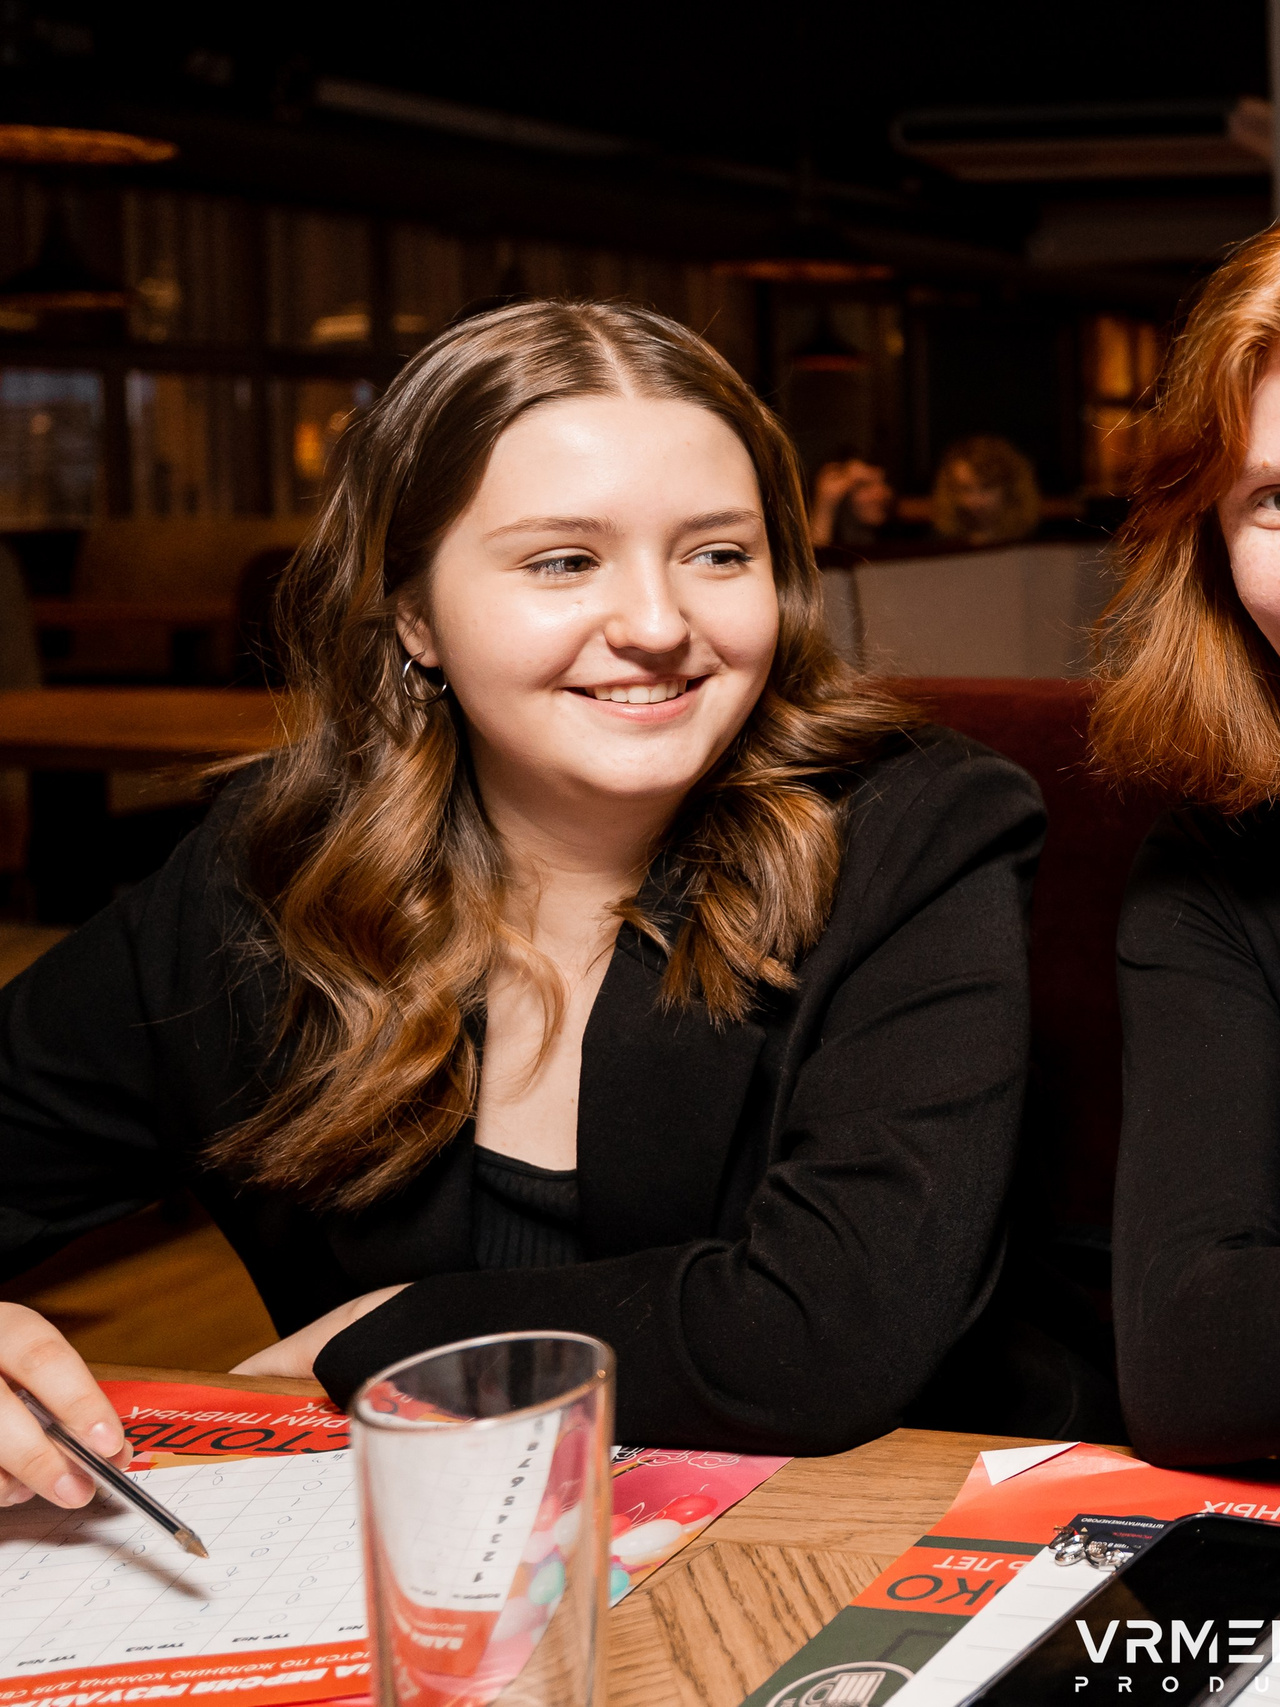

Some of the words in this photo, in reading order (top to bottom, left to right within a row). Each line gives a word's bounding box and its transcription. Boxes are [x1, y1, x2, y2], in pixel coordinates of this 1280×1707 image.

[120, 1405, 271, 1425] ПИВНЫХ
[120, 1422, 351, 1457] СТОЛЬ
[511, 1477, 525, 1489] 6
[504, 1495, 516, 1507] 5
[497, 1513, 509, 1526] 4
[1081, 1517, 1165, 1530] ШТЕЙНПАТИКЕМЕРОВО
[490, 1533, 503, 1544] 3
[484, 1550, 497, 1563] 2
[932, 1554, 1004, 1573] ЛЕТ
[473, 1571, 485, 1584] 1
[887, 1573, 1007, 1606] КО
[157, 1642, 185, 1650] ТУР
[279, 1657, 312, 1669] по
[168, 1661, 277, 1680] желанию
[78, 1671, 167, 1688] команд
[193, 1667, 329, 1697] ВЕРСИЯ
[0, 1688, 28, 1701] св
[32, 1680, 78, 1696] для
